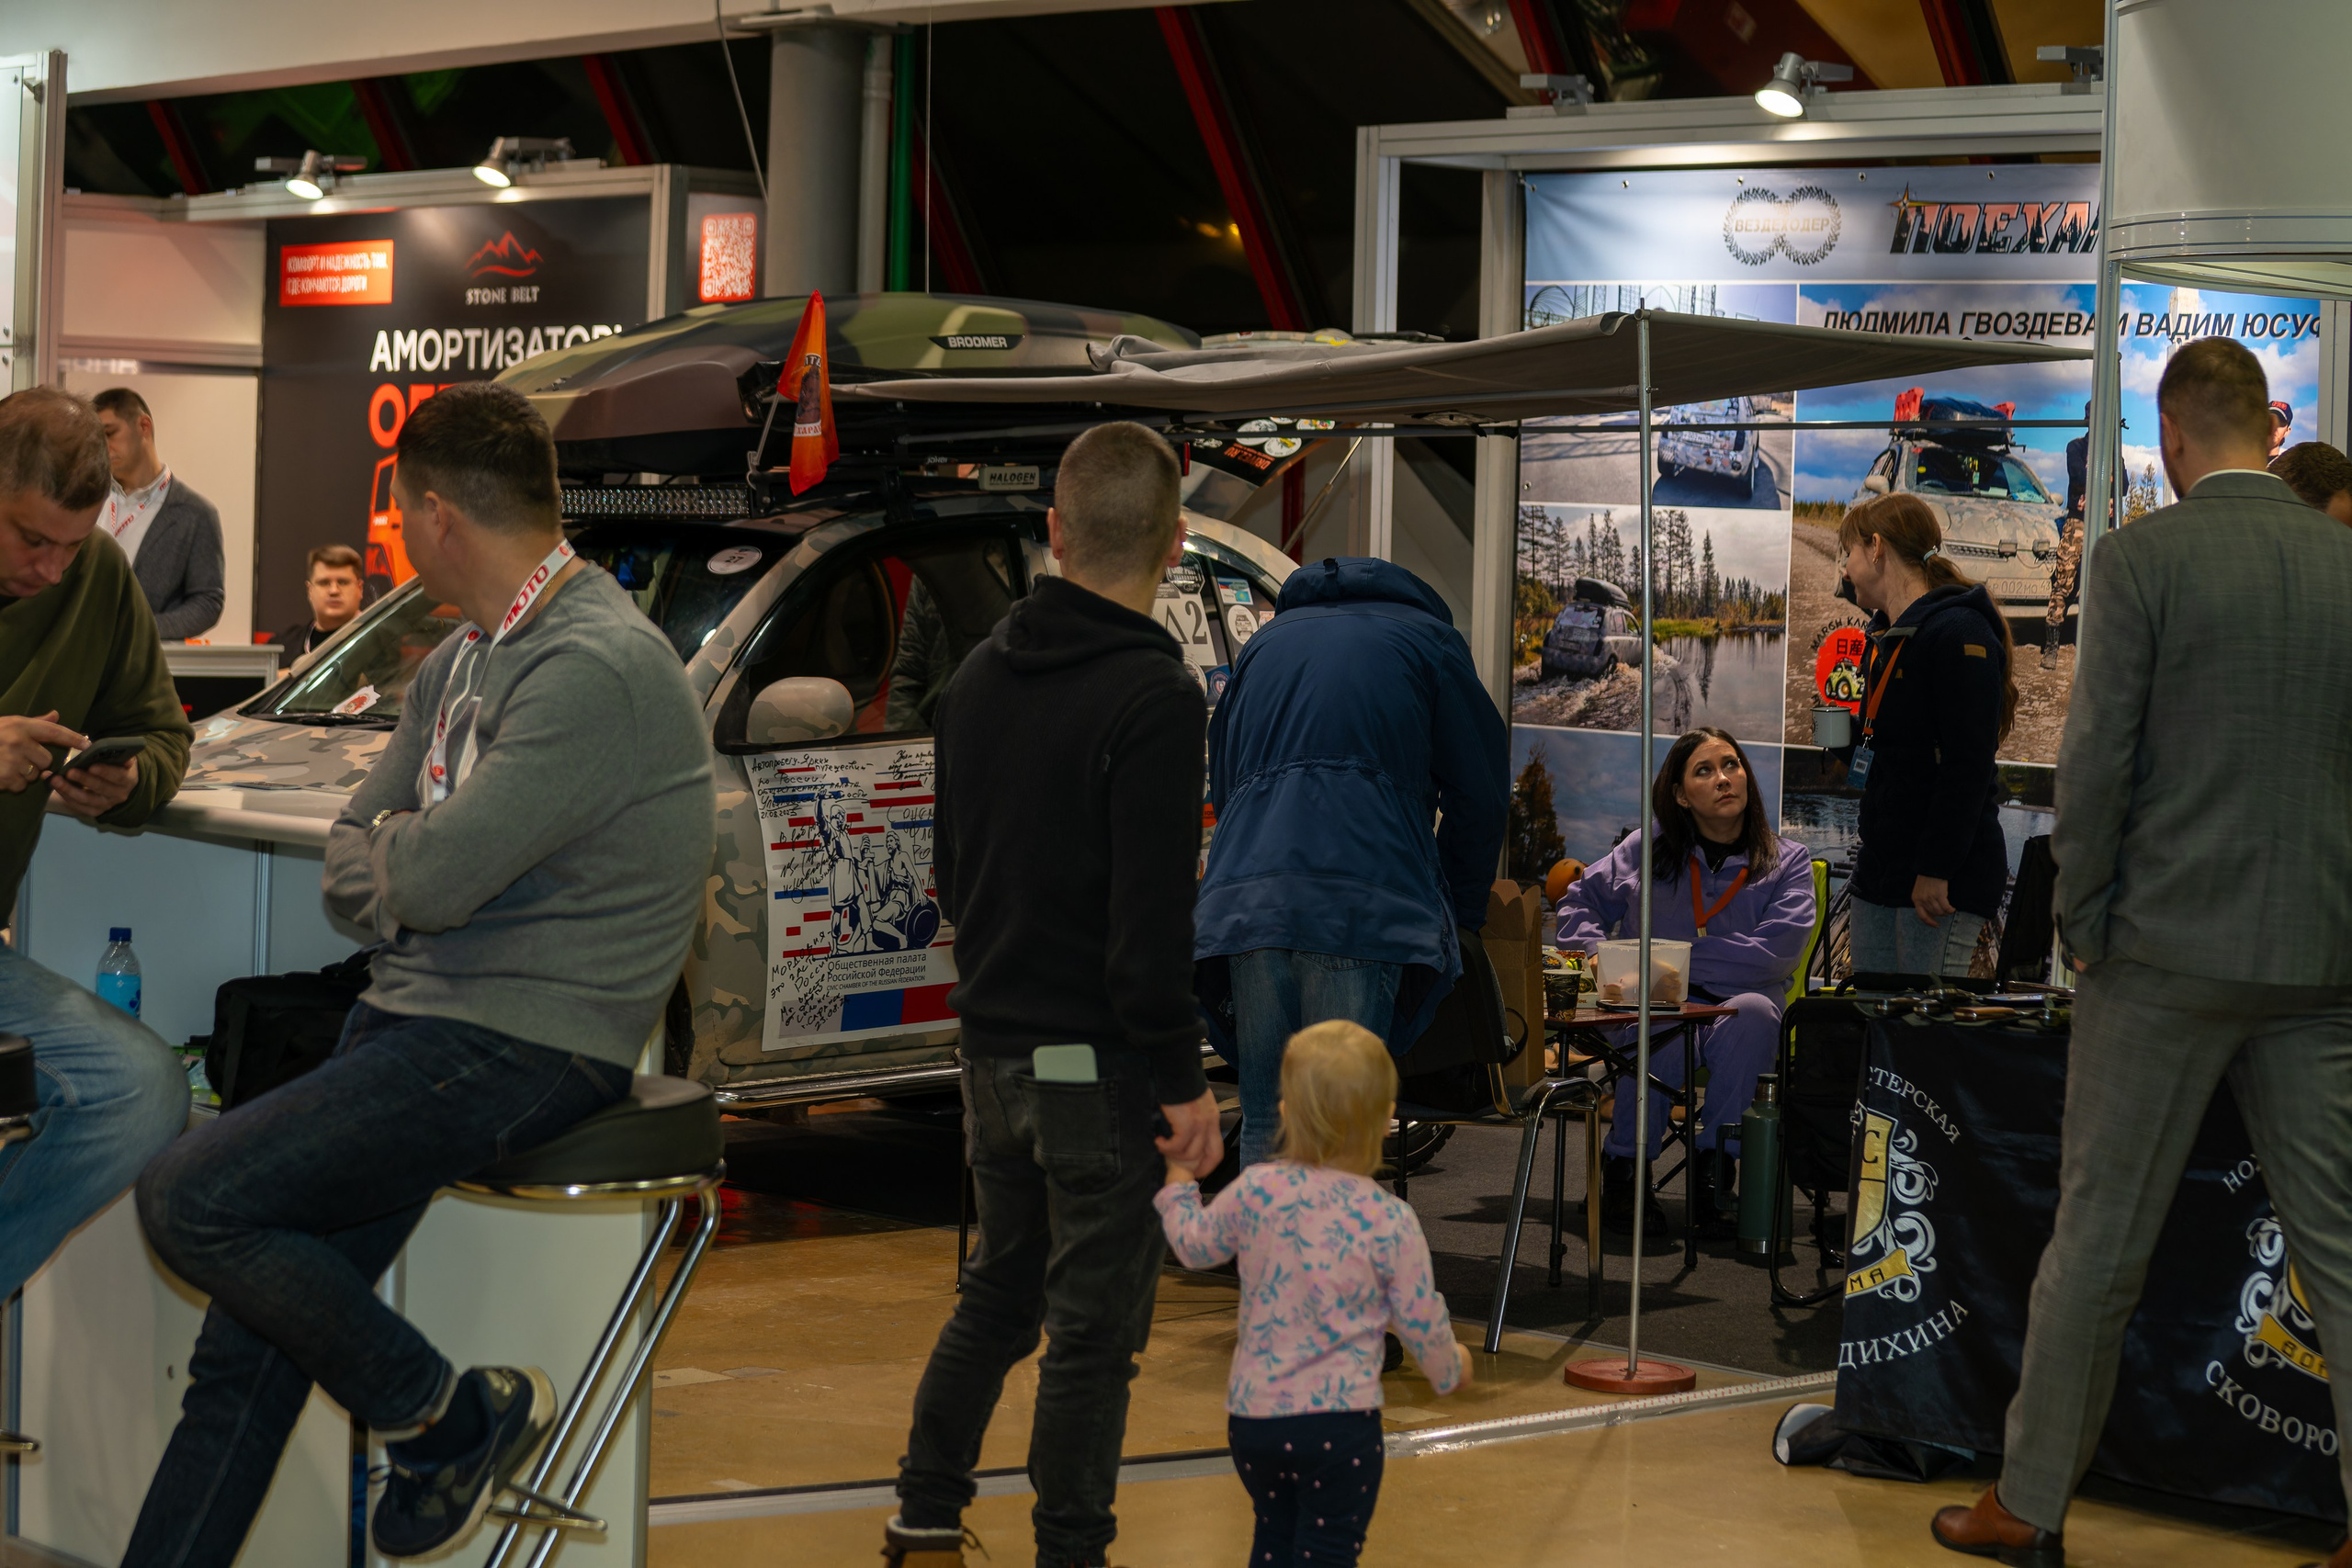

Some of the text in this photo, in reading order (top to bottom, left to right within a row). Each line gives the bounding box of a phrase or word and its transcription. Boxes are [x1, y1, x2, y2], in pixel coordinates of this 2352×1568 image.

[1735, 218, 1831, 233] ВЕЗДЕХОДЕР
[1888, 200, 2101, 254] ПОЕХА
[465, 285, 540, 306] STONE BELT
[1823, 310, 1951, 336] ЛЮДМИЛА
[2134, 313, 2233, 344] ВАДИМ
[369, 323, 623, 372] АМОРТИЗАТО
[947, 335, 1008, 348] BROOMER
[989, 471, 1037, 483] HALOGEN
[1836, 638, 1863, 657] 日産
[828, 953, 927, 971] Общественная палата
[827, 964, 926, 983] Российской Федерации
[838, 980, 862, 990] CHAMBER
[878, 977, 899, 986] RUSSIAN
[898, 975, 926, 984] FEDERATION
[2221, 1154, 2260, 1194] НО
[1838, 1299, 1969, 1371] ДИХИНА
